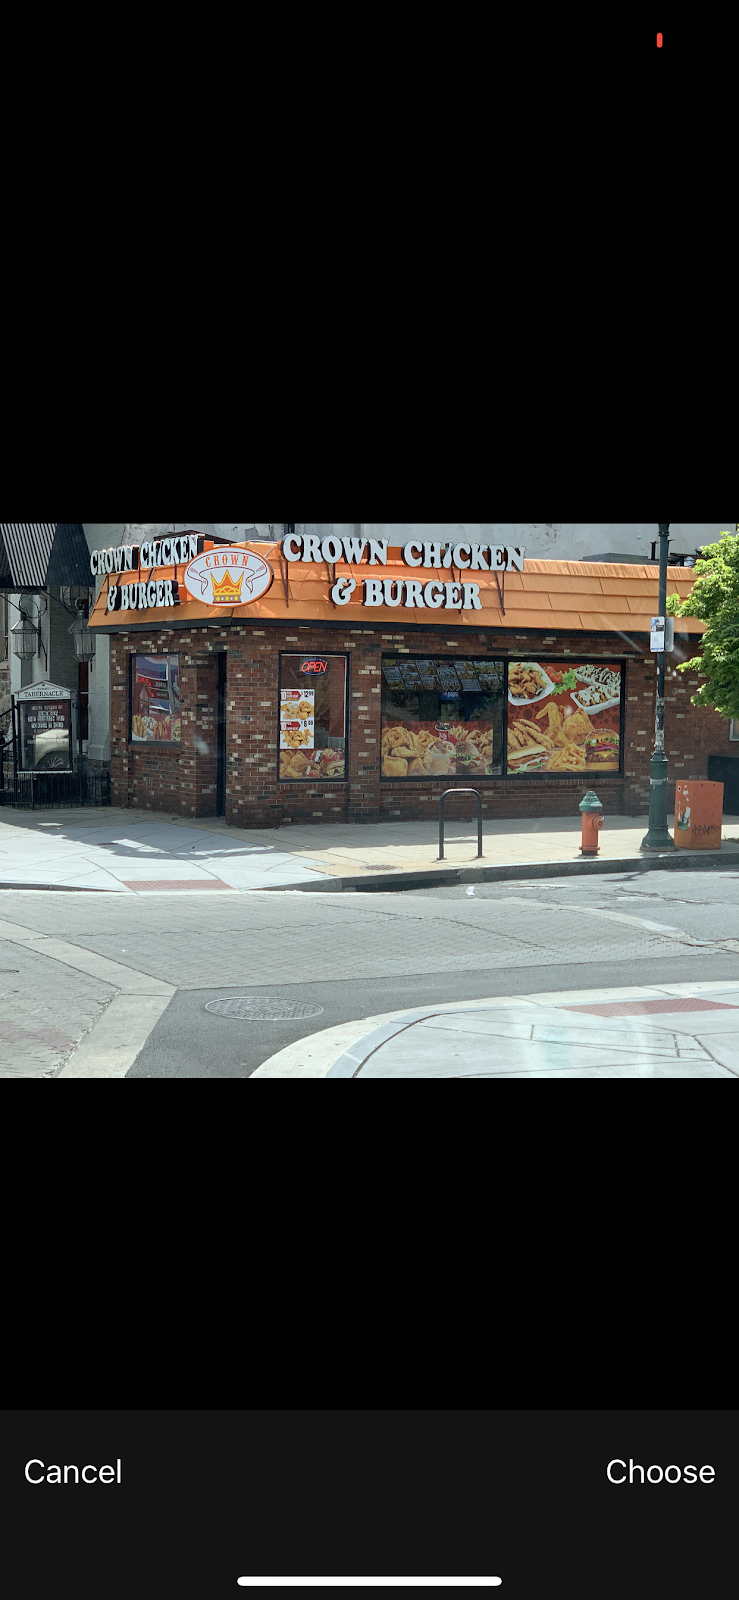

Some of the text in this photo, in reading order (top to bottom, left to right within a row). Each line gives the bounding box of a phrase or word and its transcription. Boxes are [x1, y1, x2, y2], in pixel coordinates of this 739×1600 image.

[90, 534, 200, 575] CROWN CHICKEN
[205, 553, 250, 568] CROWN
[282, 533, 527, 572] CROWN CHICKEN
[107, 579, 176, 611] & BURGER
[331, 577, 483, 610] & BURGER
[301, 661, 328, 673] OPEN
